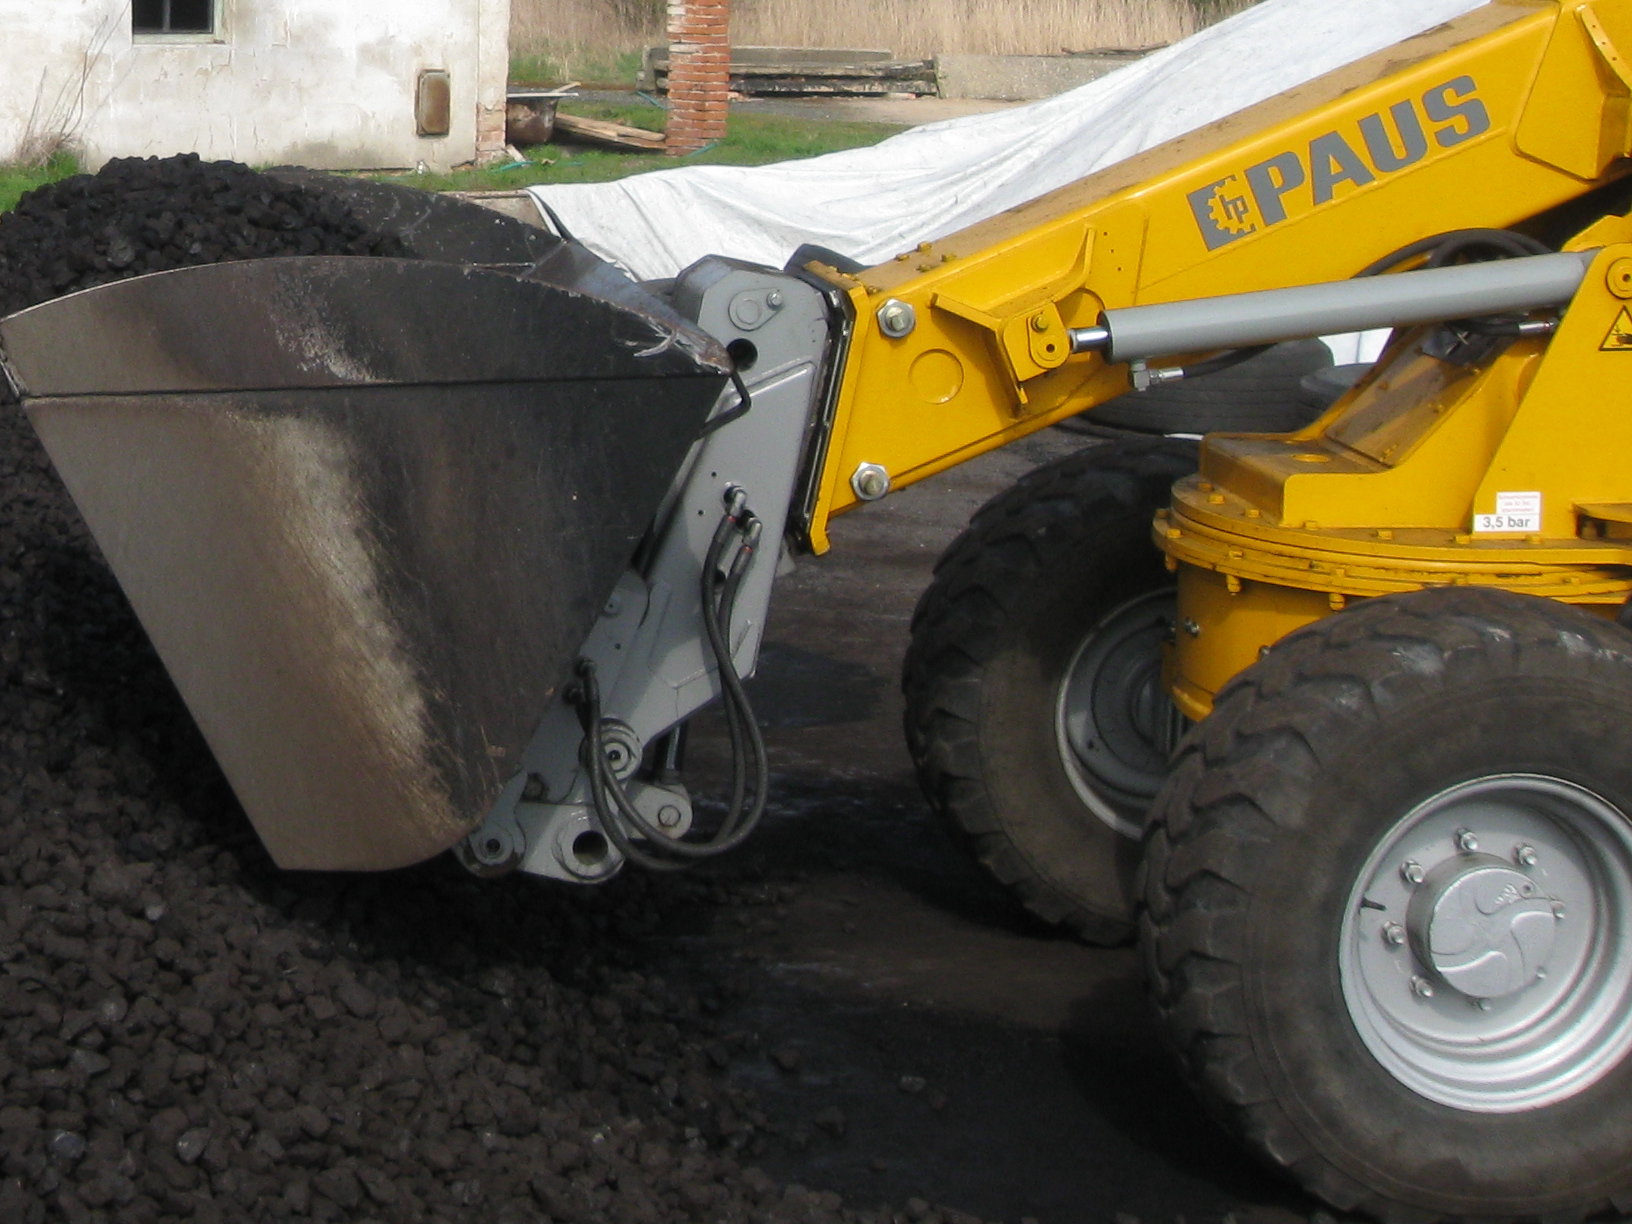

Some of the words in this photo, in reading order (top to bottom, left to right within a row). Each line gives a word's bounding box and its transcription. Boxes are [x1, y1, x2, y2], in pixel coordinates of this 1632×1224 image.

[1243, 74, 1491, 227] PAUS
[1482, 515, 1504, 530] 3,5
[1507, 515, 1531, 528] bar
